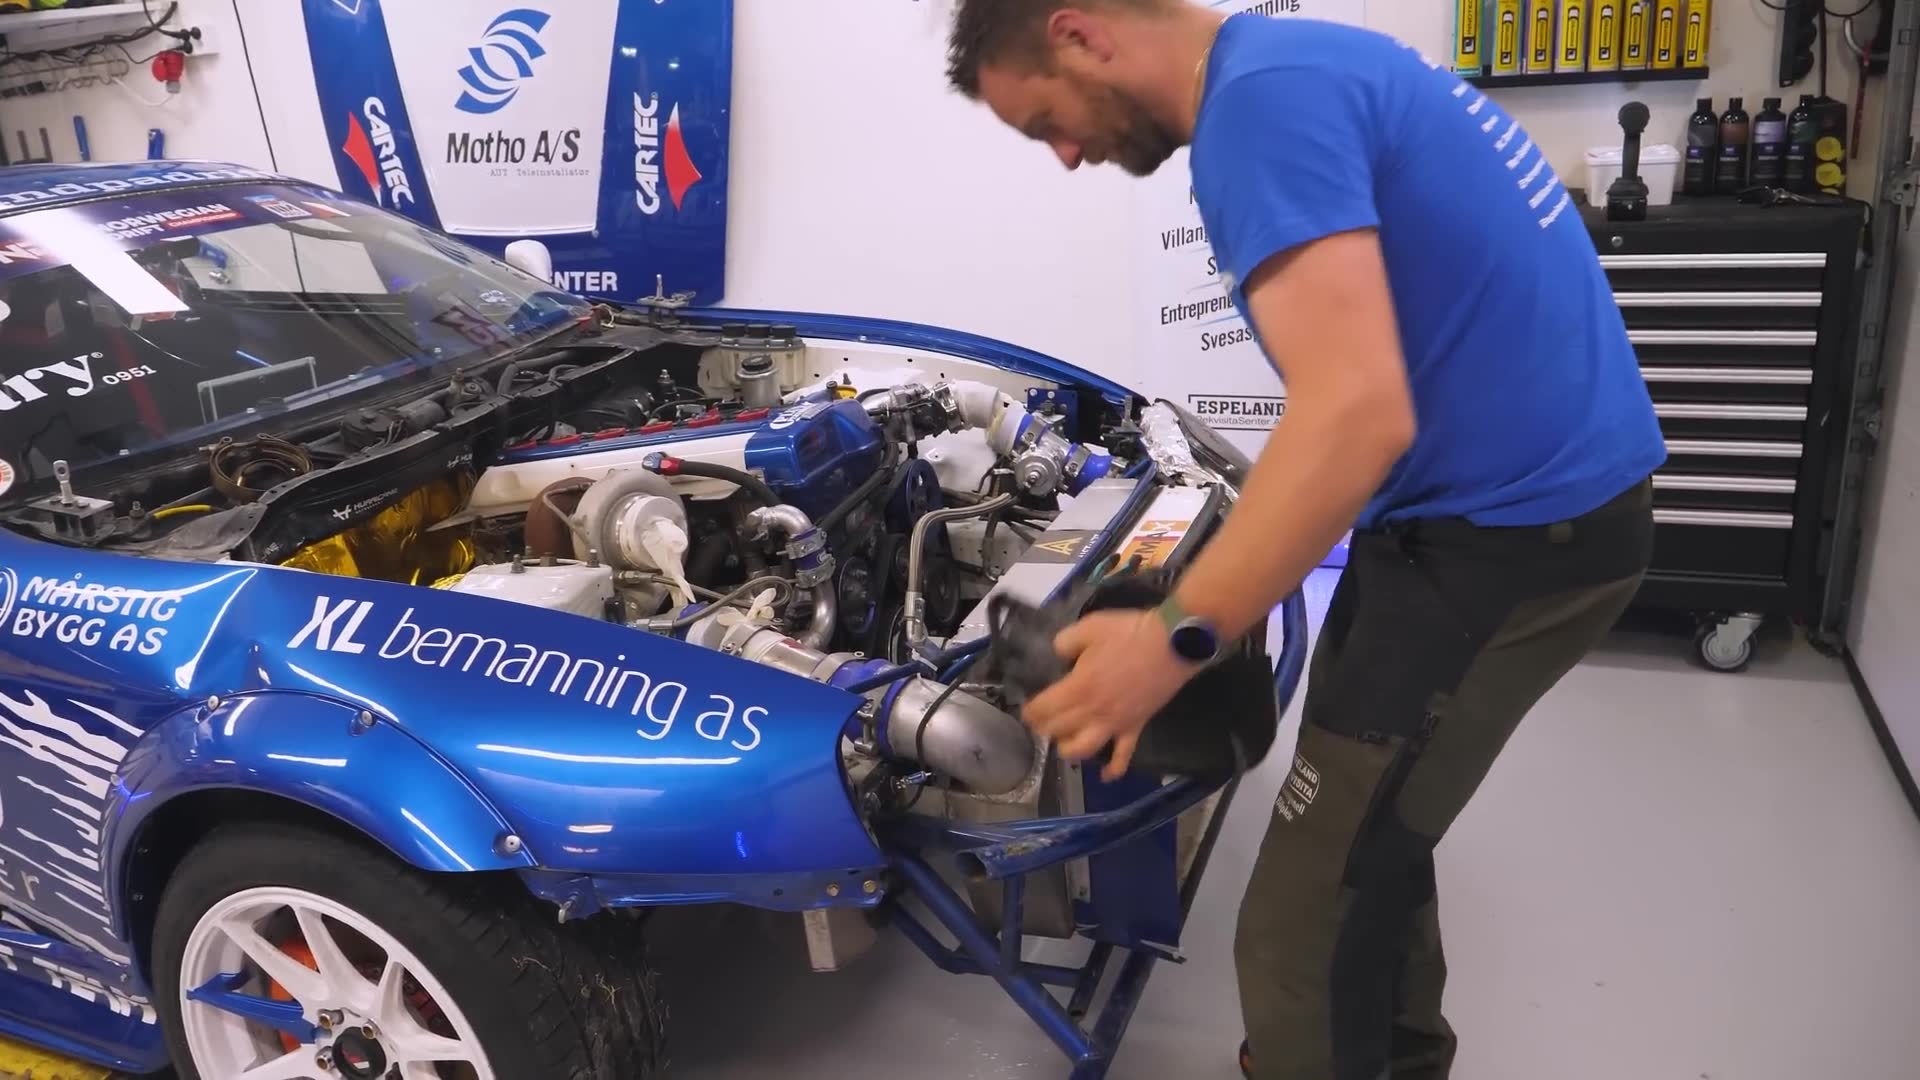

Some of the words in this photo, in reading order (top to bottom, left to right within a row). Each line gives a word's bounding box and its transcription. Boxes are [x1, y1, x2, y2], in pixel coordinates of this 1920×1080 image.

[364, 96, 415, 206] CARTEC
[446, 130, 525, 163] Motho
[532, 129, 581, 165] A/S
[635, 92, 661, 215] CARTEC
[1161, 226, 1209, 250] Villan
[1201, 327, 1258, 351] Svesas
[103, 364, 157, 385] 0951
[1197, 400, 1286, 416] ESPELAND
[12, 607, 106, 647] BYGG
[109, 623, 168, 655] AS
[286, 595, 374, 654] XL
[378, 608, 688, 741] bemanning
[694, 693, 769, 751] as
